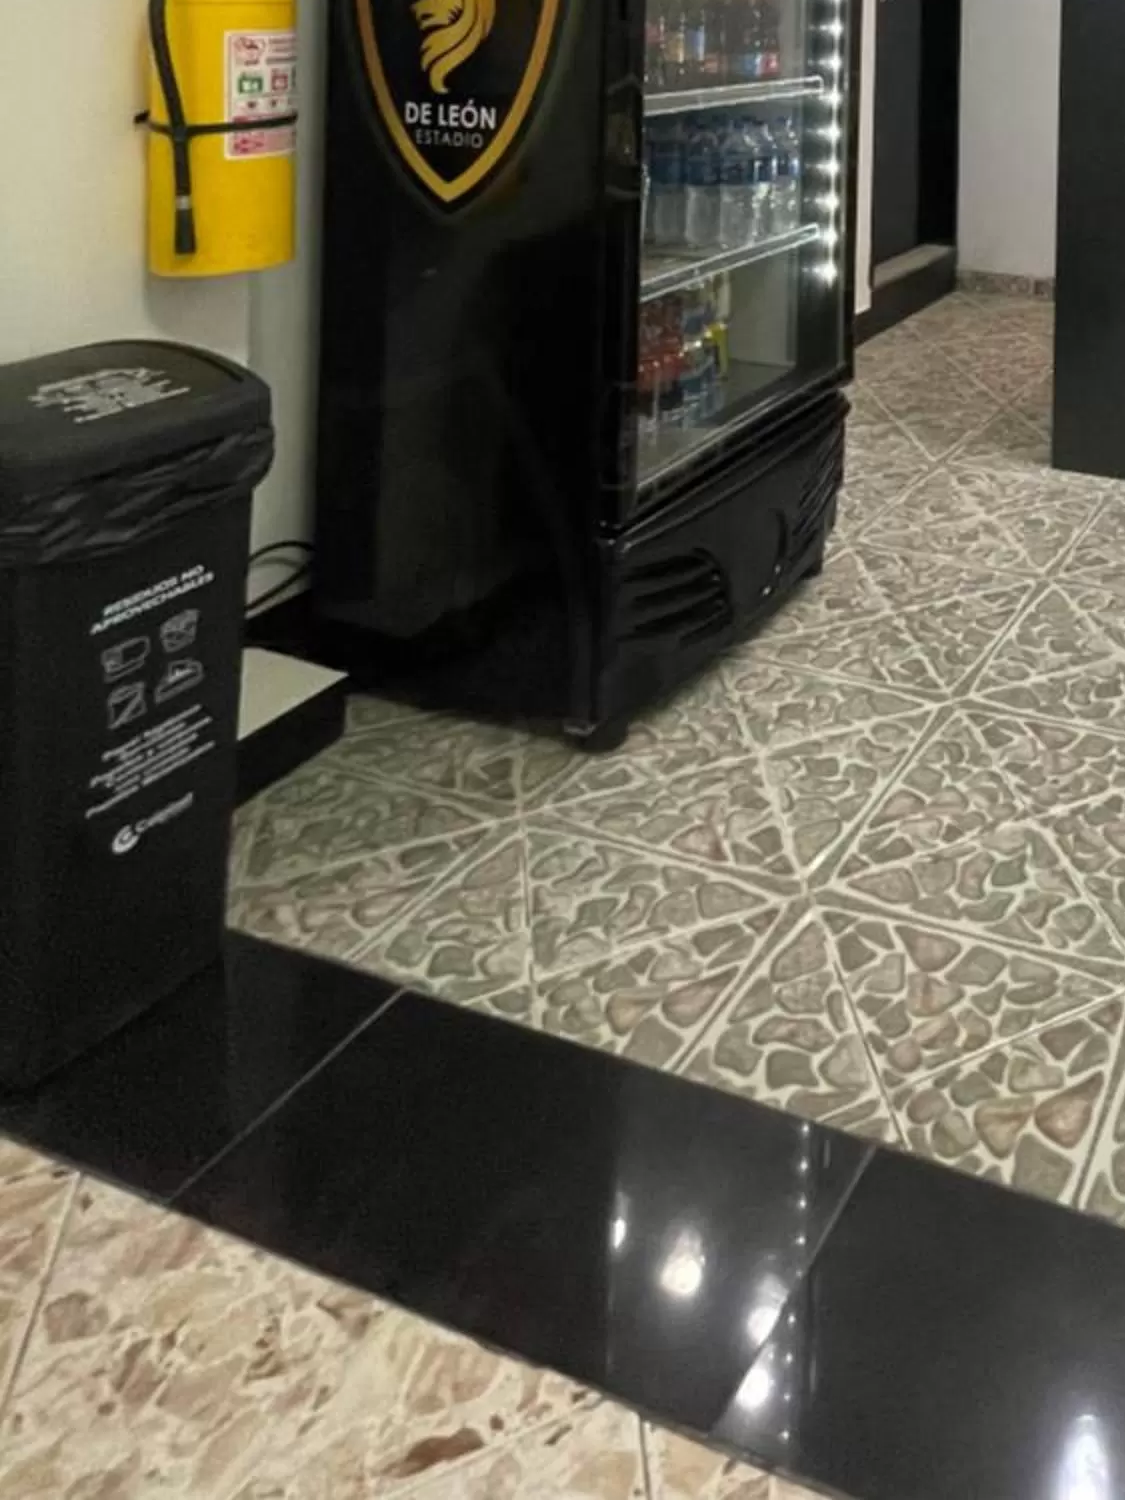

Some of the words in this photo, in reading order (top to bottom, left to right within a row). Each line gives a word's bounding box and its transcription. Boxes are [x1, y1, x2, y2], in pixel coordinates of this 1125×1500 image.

[404, 100, 433, 126] DE
[437, 97, 498, 130] LEÓN
[415, 128, 484, 149] ESTADIO
